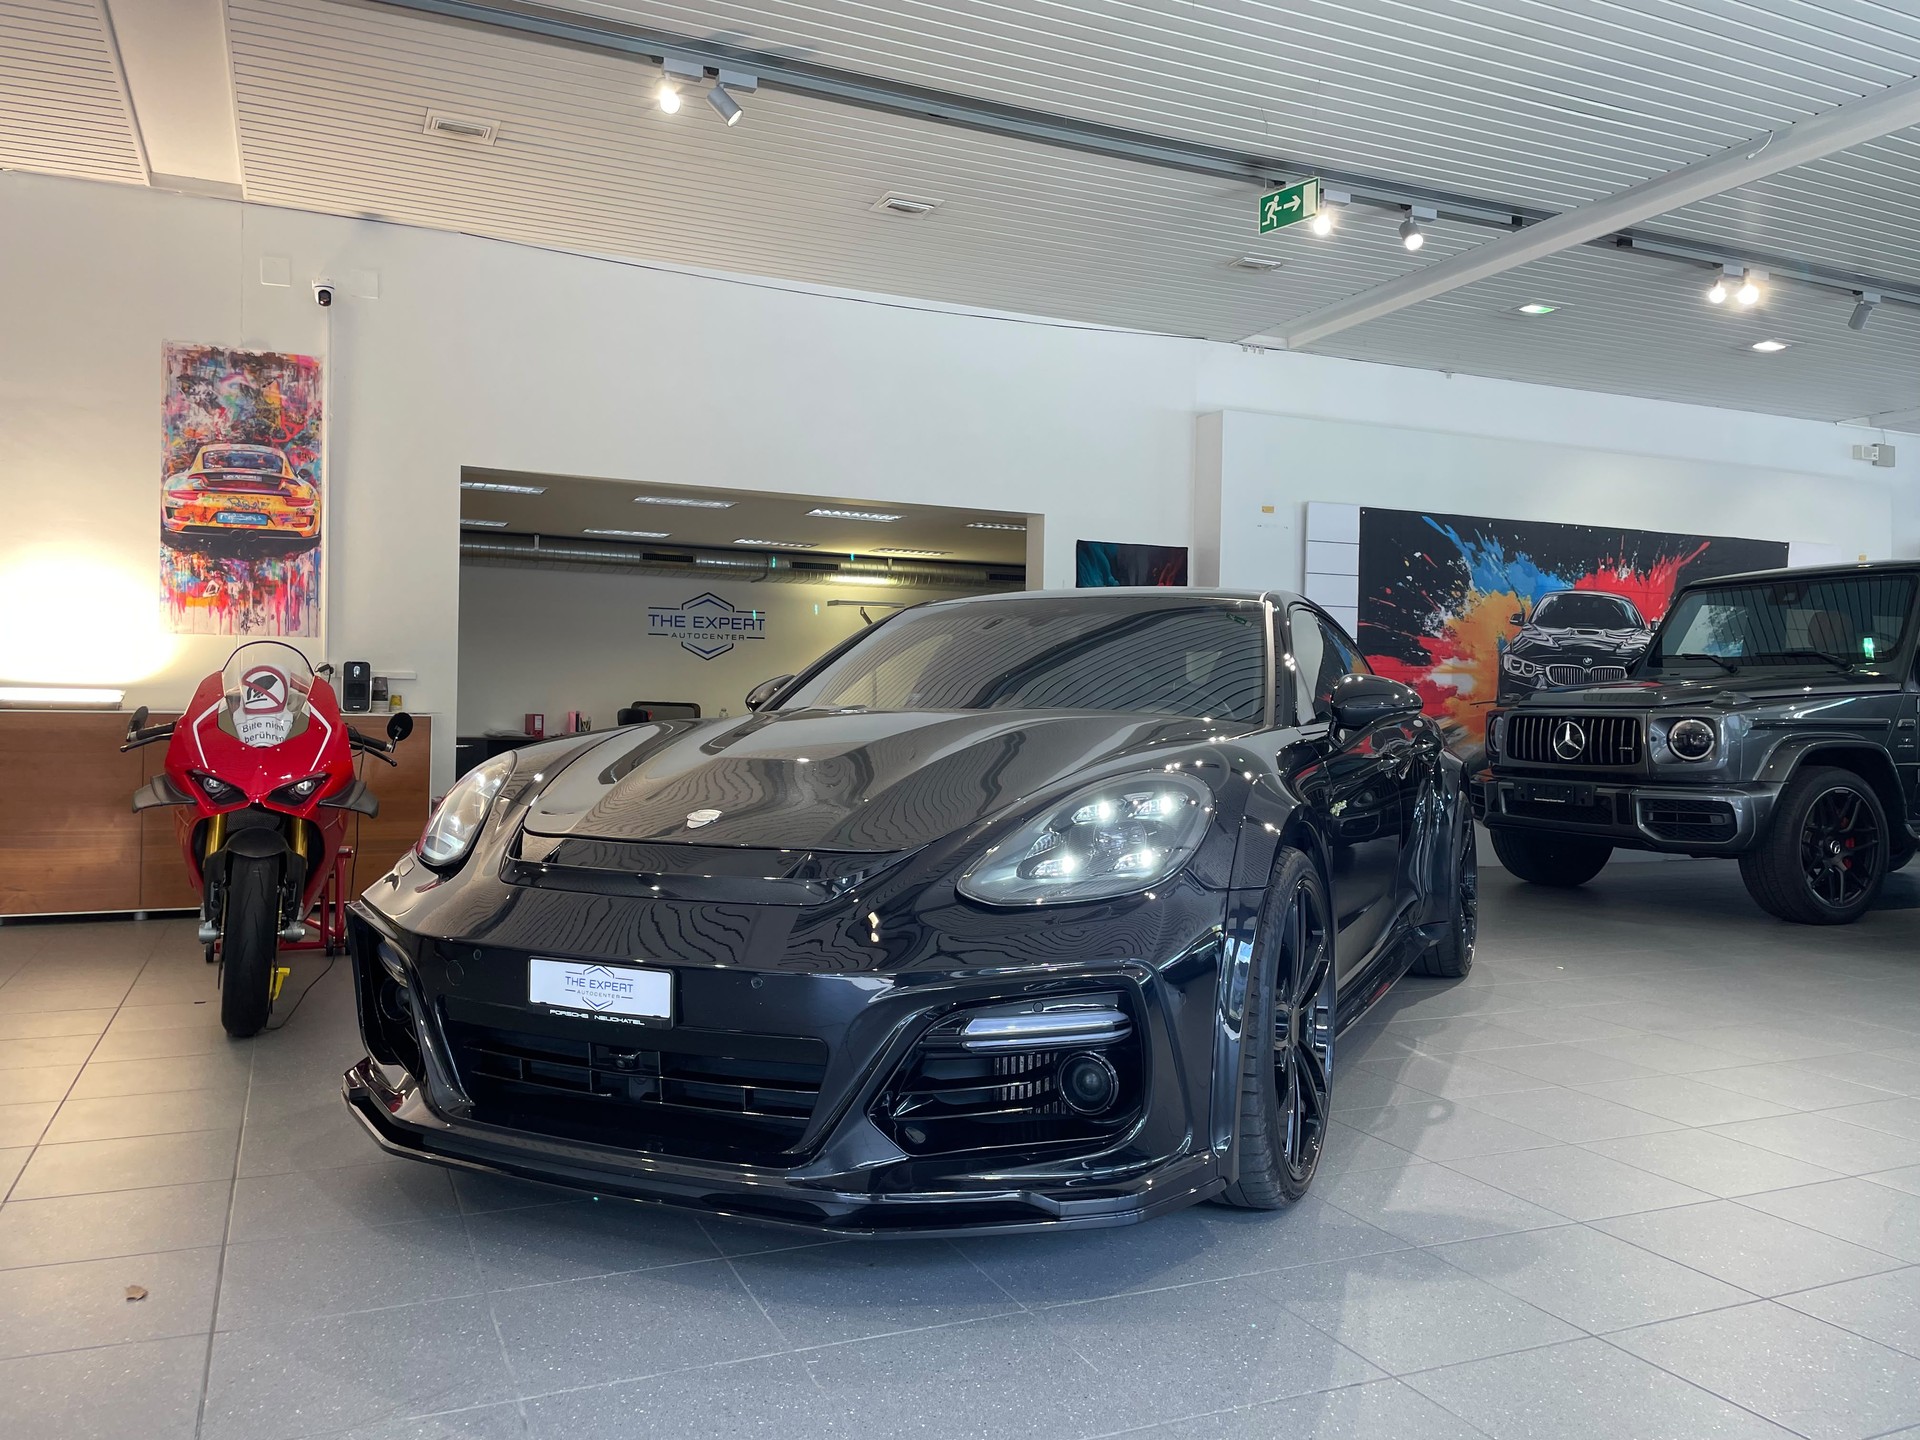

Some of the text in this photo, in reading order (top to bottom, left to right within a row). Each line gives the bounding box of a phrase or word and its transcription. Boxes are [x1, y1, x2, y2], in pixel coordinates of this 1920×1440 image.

[648, 614, 765, 631] THE EXPERT
[671, 632, 745, 640] AUTOCENTER
[242, 721, 262, 732] Bitte
[244, 732, 285, 743] berühren
[565, 976, 633, 992] THE EXPERT
[577, 990, 620, 998] AUTOCENTER
[550, 1010, 588, 1018] PORSCHE
